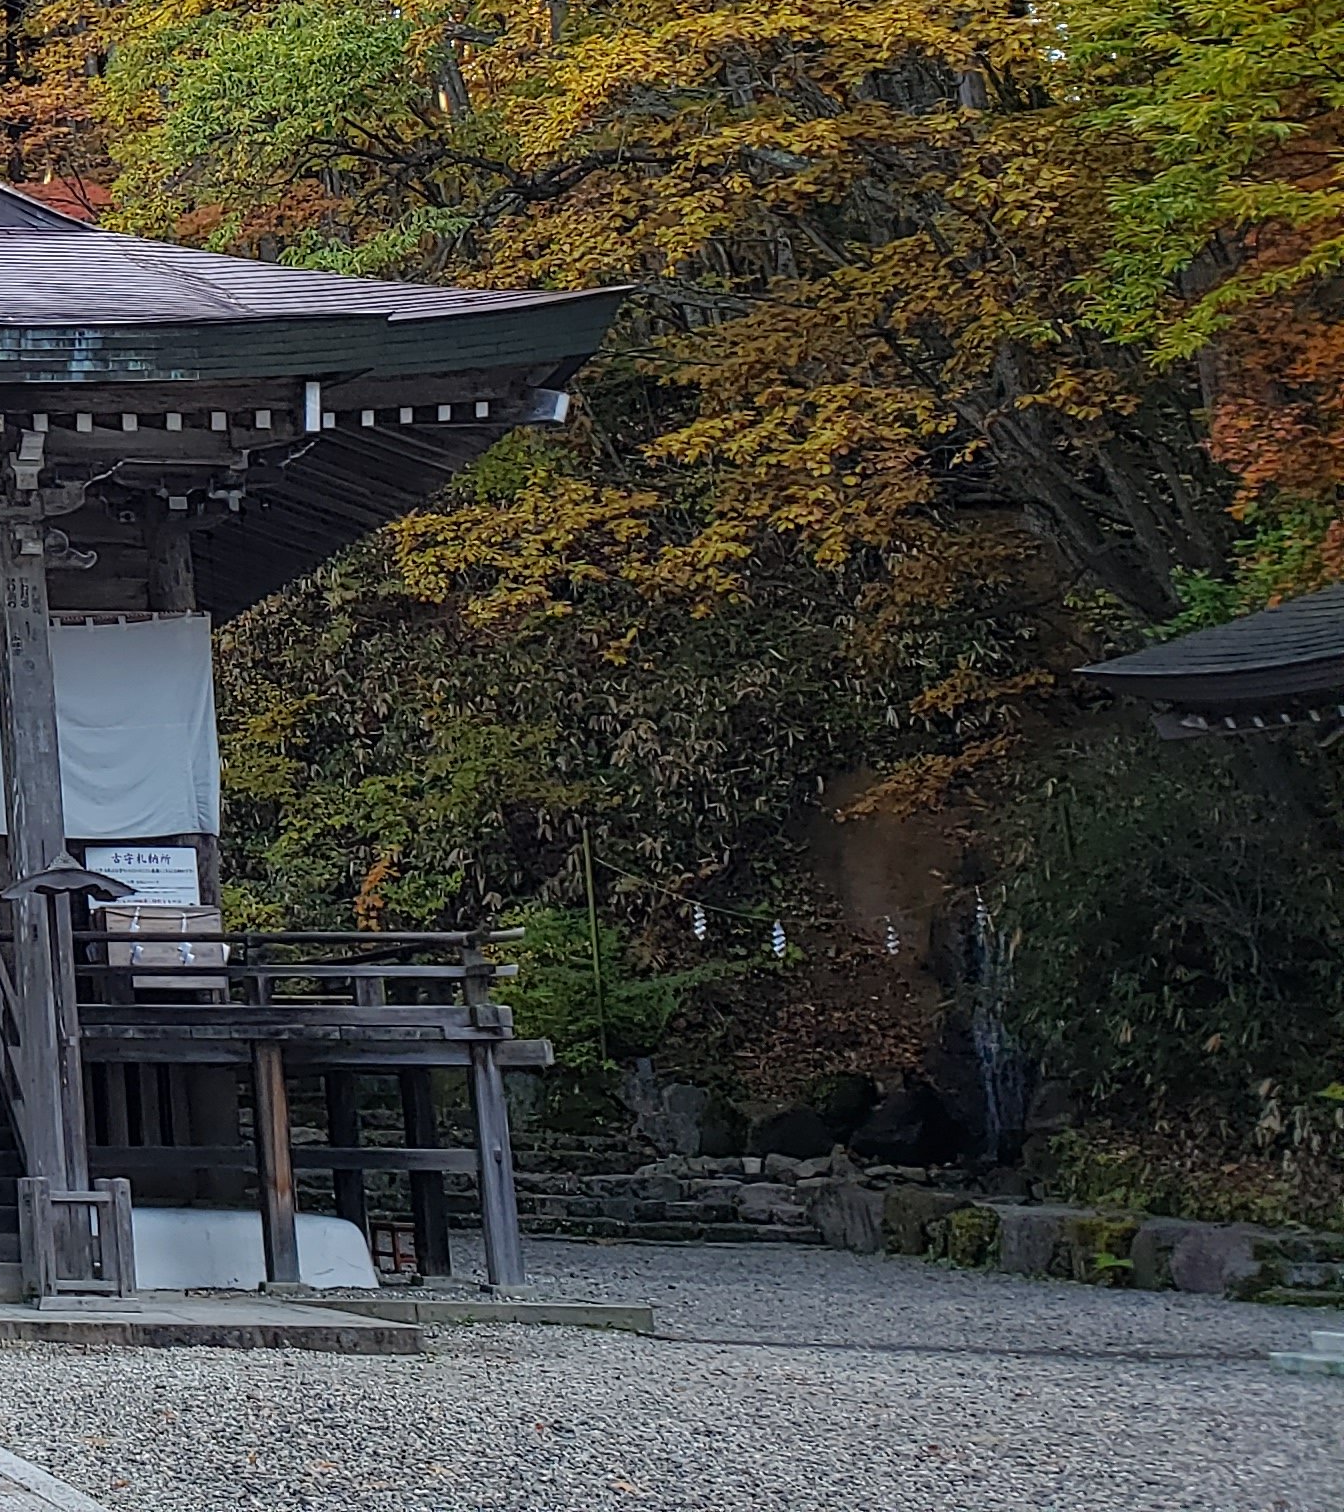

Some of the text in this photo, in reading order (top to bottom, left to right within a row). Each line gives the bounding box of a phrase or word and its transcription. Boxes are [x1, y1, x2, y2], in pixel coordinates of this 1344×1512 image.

[111, 852, 171, 865] 古守札納所
